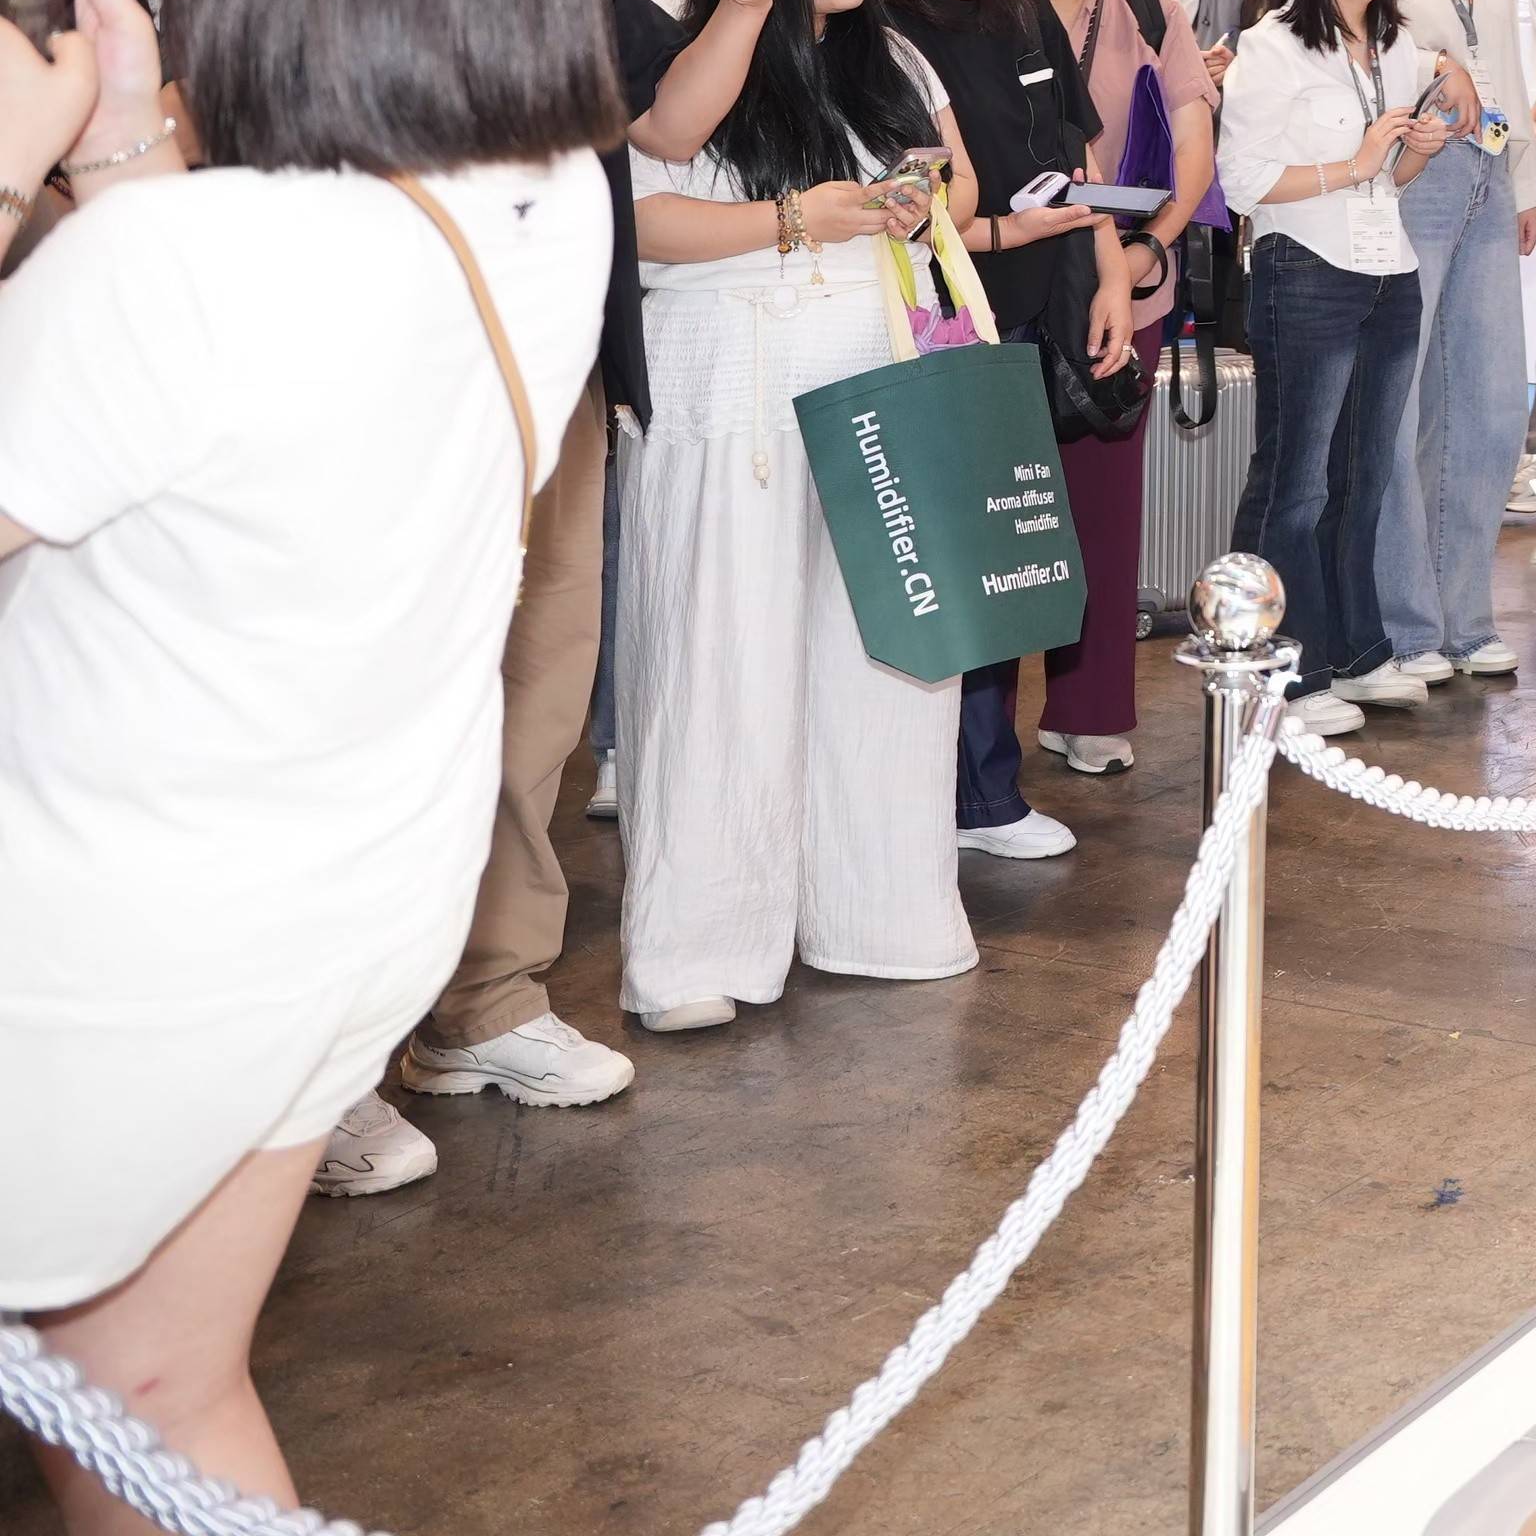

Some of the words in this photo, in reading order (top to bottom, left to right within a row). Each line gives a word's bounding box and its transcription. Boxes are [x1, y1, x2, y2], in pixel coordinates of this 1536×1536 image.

[1014, 464, 1034, 482] Mini
[1035, 463, 1051, 479] Fan
[987, 494, 1021, 513] Aroma
[1021, 489, 1055, 507] diffuser
[851, 410, 939, 617] Humidifier.CN
[1015, 513, 1060, 535] Humidifier
[981, 560, 1070, 596] Humidifier.CN
